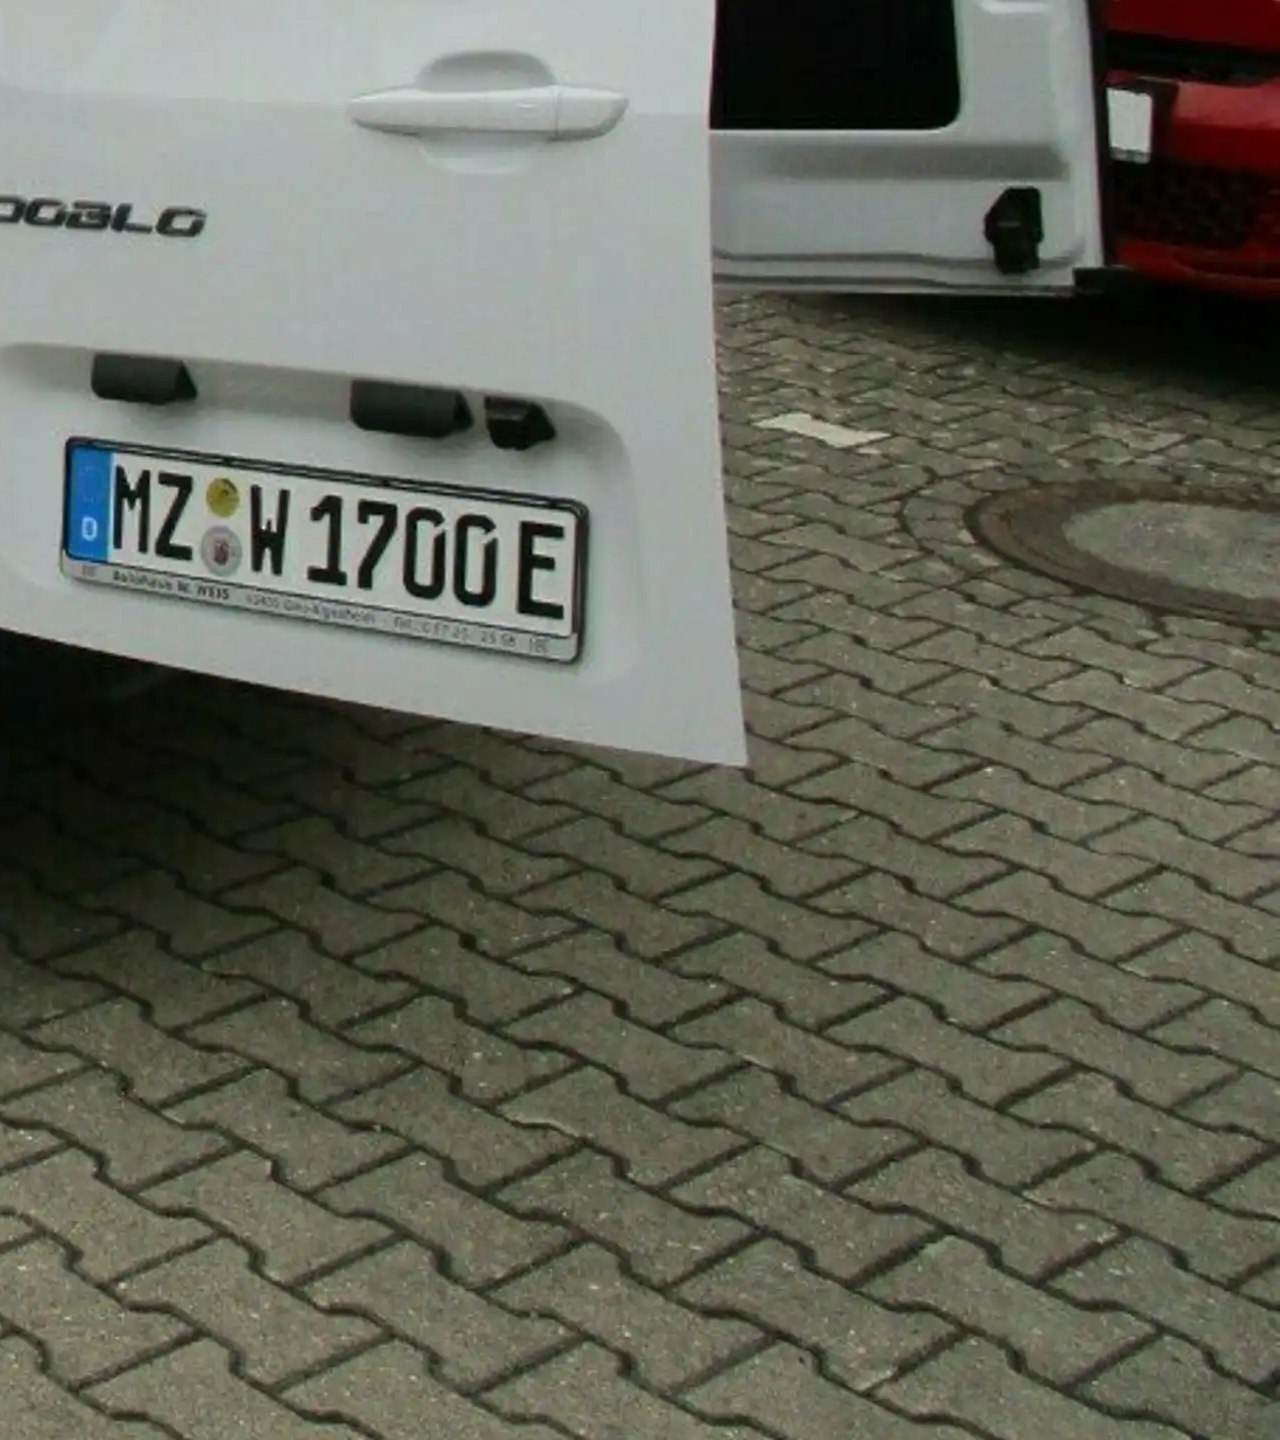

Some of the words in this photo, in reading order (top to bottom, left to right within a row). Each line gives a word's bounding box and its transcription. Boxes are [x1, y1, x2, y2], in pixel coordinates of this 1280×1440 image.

[81, 516, 98, 541] D
[112, 465, 194, 562] MZ
[249, 484, 291, 576] W
